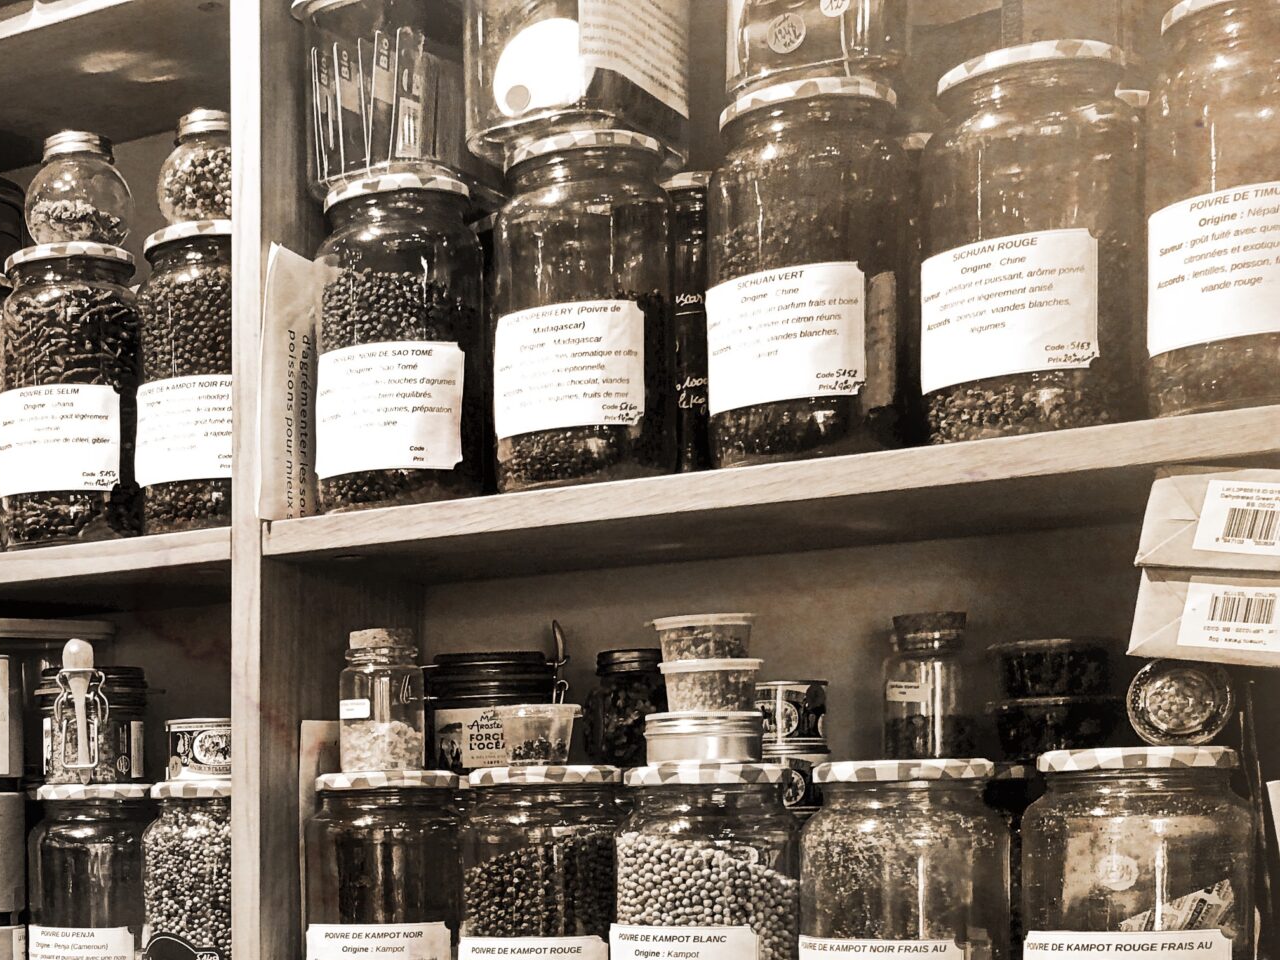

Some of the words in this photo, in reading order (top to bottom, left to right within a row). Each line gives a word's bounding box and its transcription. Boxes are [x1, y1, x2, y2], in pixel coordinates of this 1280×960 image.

[1190, 195, 1230, 212] POIVRE
[1234, 191, 1249, 201] DE
[1199, 213, 1237, 227] Origine
[953, 244, 995, 262] SICHUAN
[997, 237, 1038, 250] ROUGE
[961, 262, 991, 275] Origine
[737, 275, 775, 289] SICHUAN
[778, 270, 804, 281] VERT
[1234, 277, 1262, 287] rouge
[578, 306, 608, 315] (Poivre
[287, 329, 296, 411] poissons
[412, 406, 452, 414] préparation
[693, 935, 727, 943] BLANC
[71, 943, 108, 951] (Cameroun)
[342, 946, 368, 954] Origine
[550, 946, 582, 954] ROUGE
[830, 945, 868, 953] KAMPOT
[870, 945, 895, 953] NOIR
[898, 945, 929, 953] FRAIS
[931, 945, 947, 953] AU
[1052, 943, 1064, 951] DE
[1115, 943, 1158, 952] ROUGE
[1161, 942, 1194, 950] FRAIS
[1197, 941, 1212, 949] AU
[635, 949, 660, 958] Origine
[667, 951, 699, 959] Kampot
